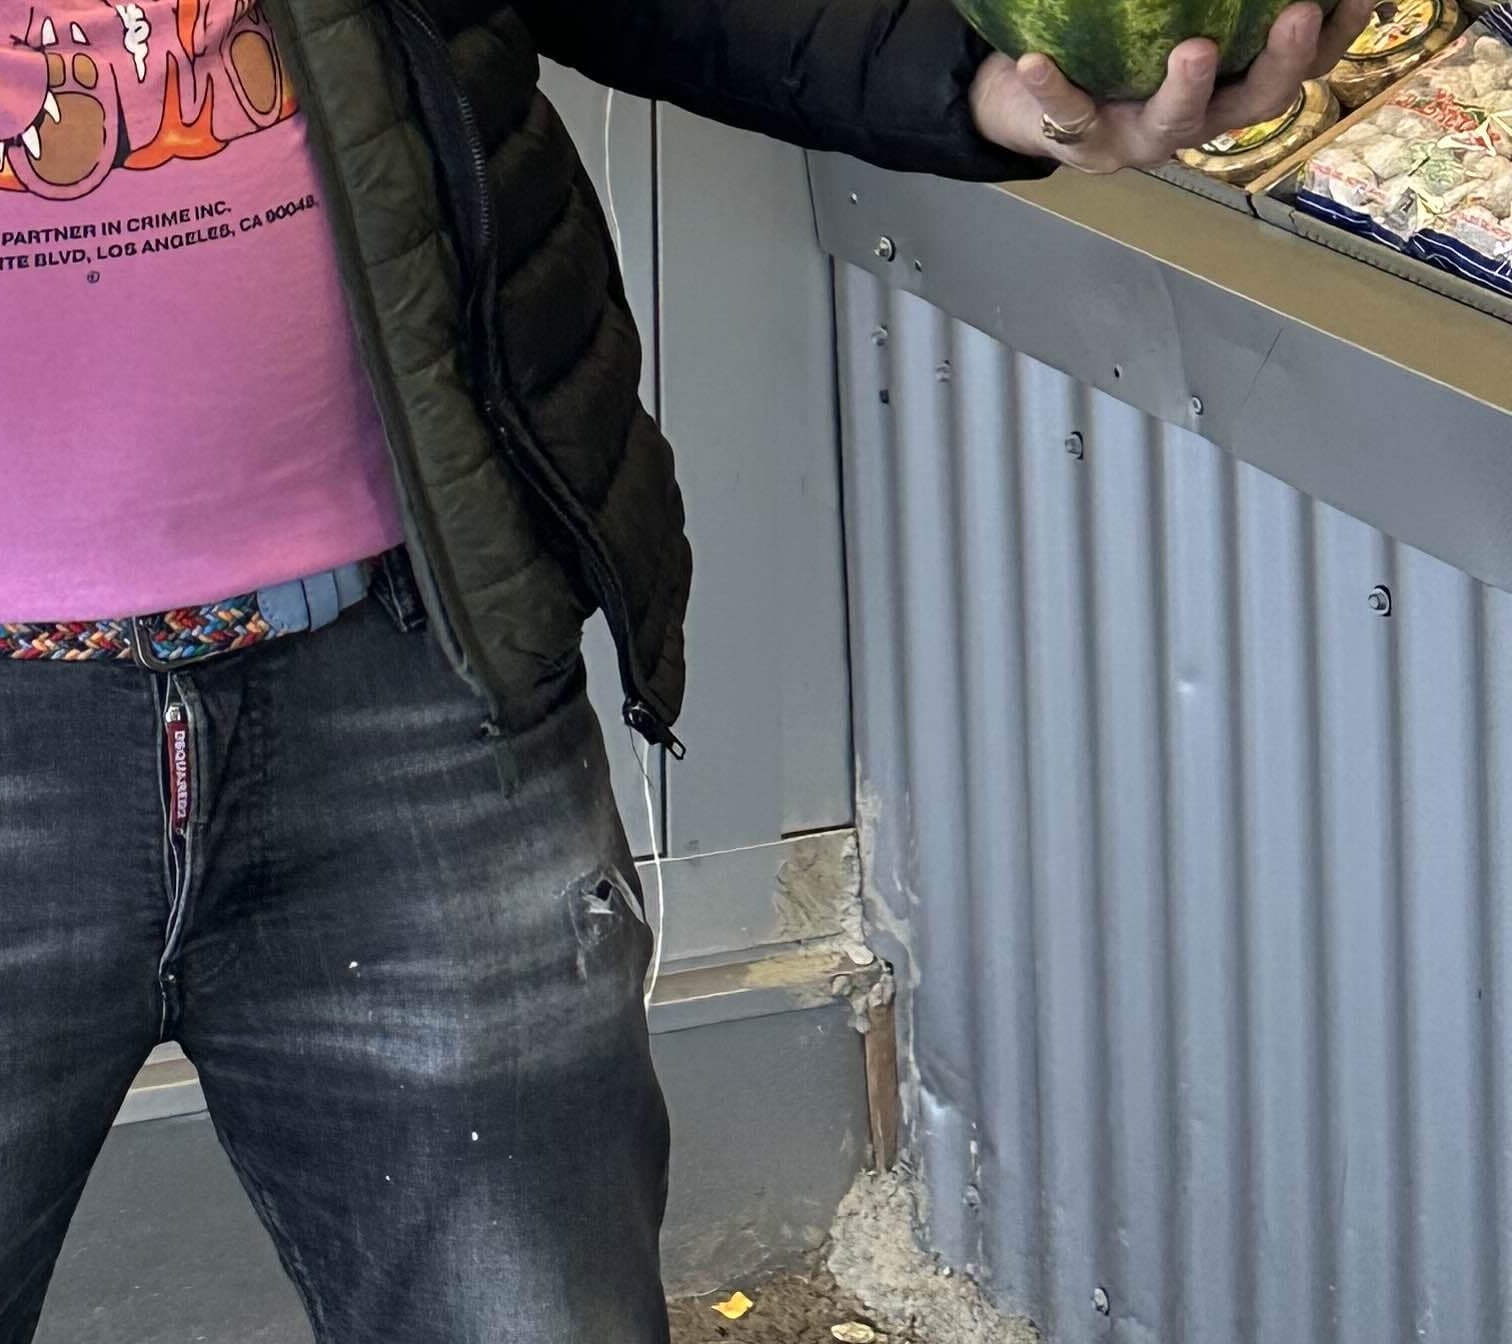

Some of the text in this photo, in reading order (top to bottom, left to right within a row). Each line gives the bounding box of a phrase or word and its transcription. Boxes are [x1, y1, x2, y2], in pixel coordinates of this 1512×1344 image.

[2, 223, 97, 247] PARTNER
[102, 220, 122, 237] IN
[127, 208, 191, 233] CRIME
[195, 201, 232, 221] INC.
[35, 247, 92, 268] BLVD,
[96, 242, 138, 261] LOS
[240, 214, 263, 232] CA
